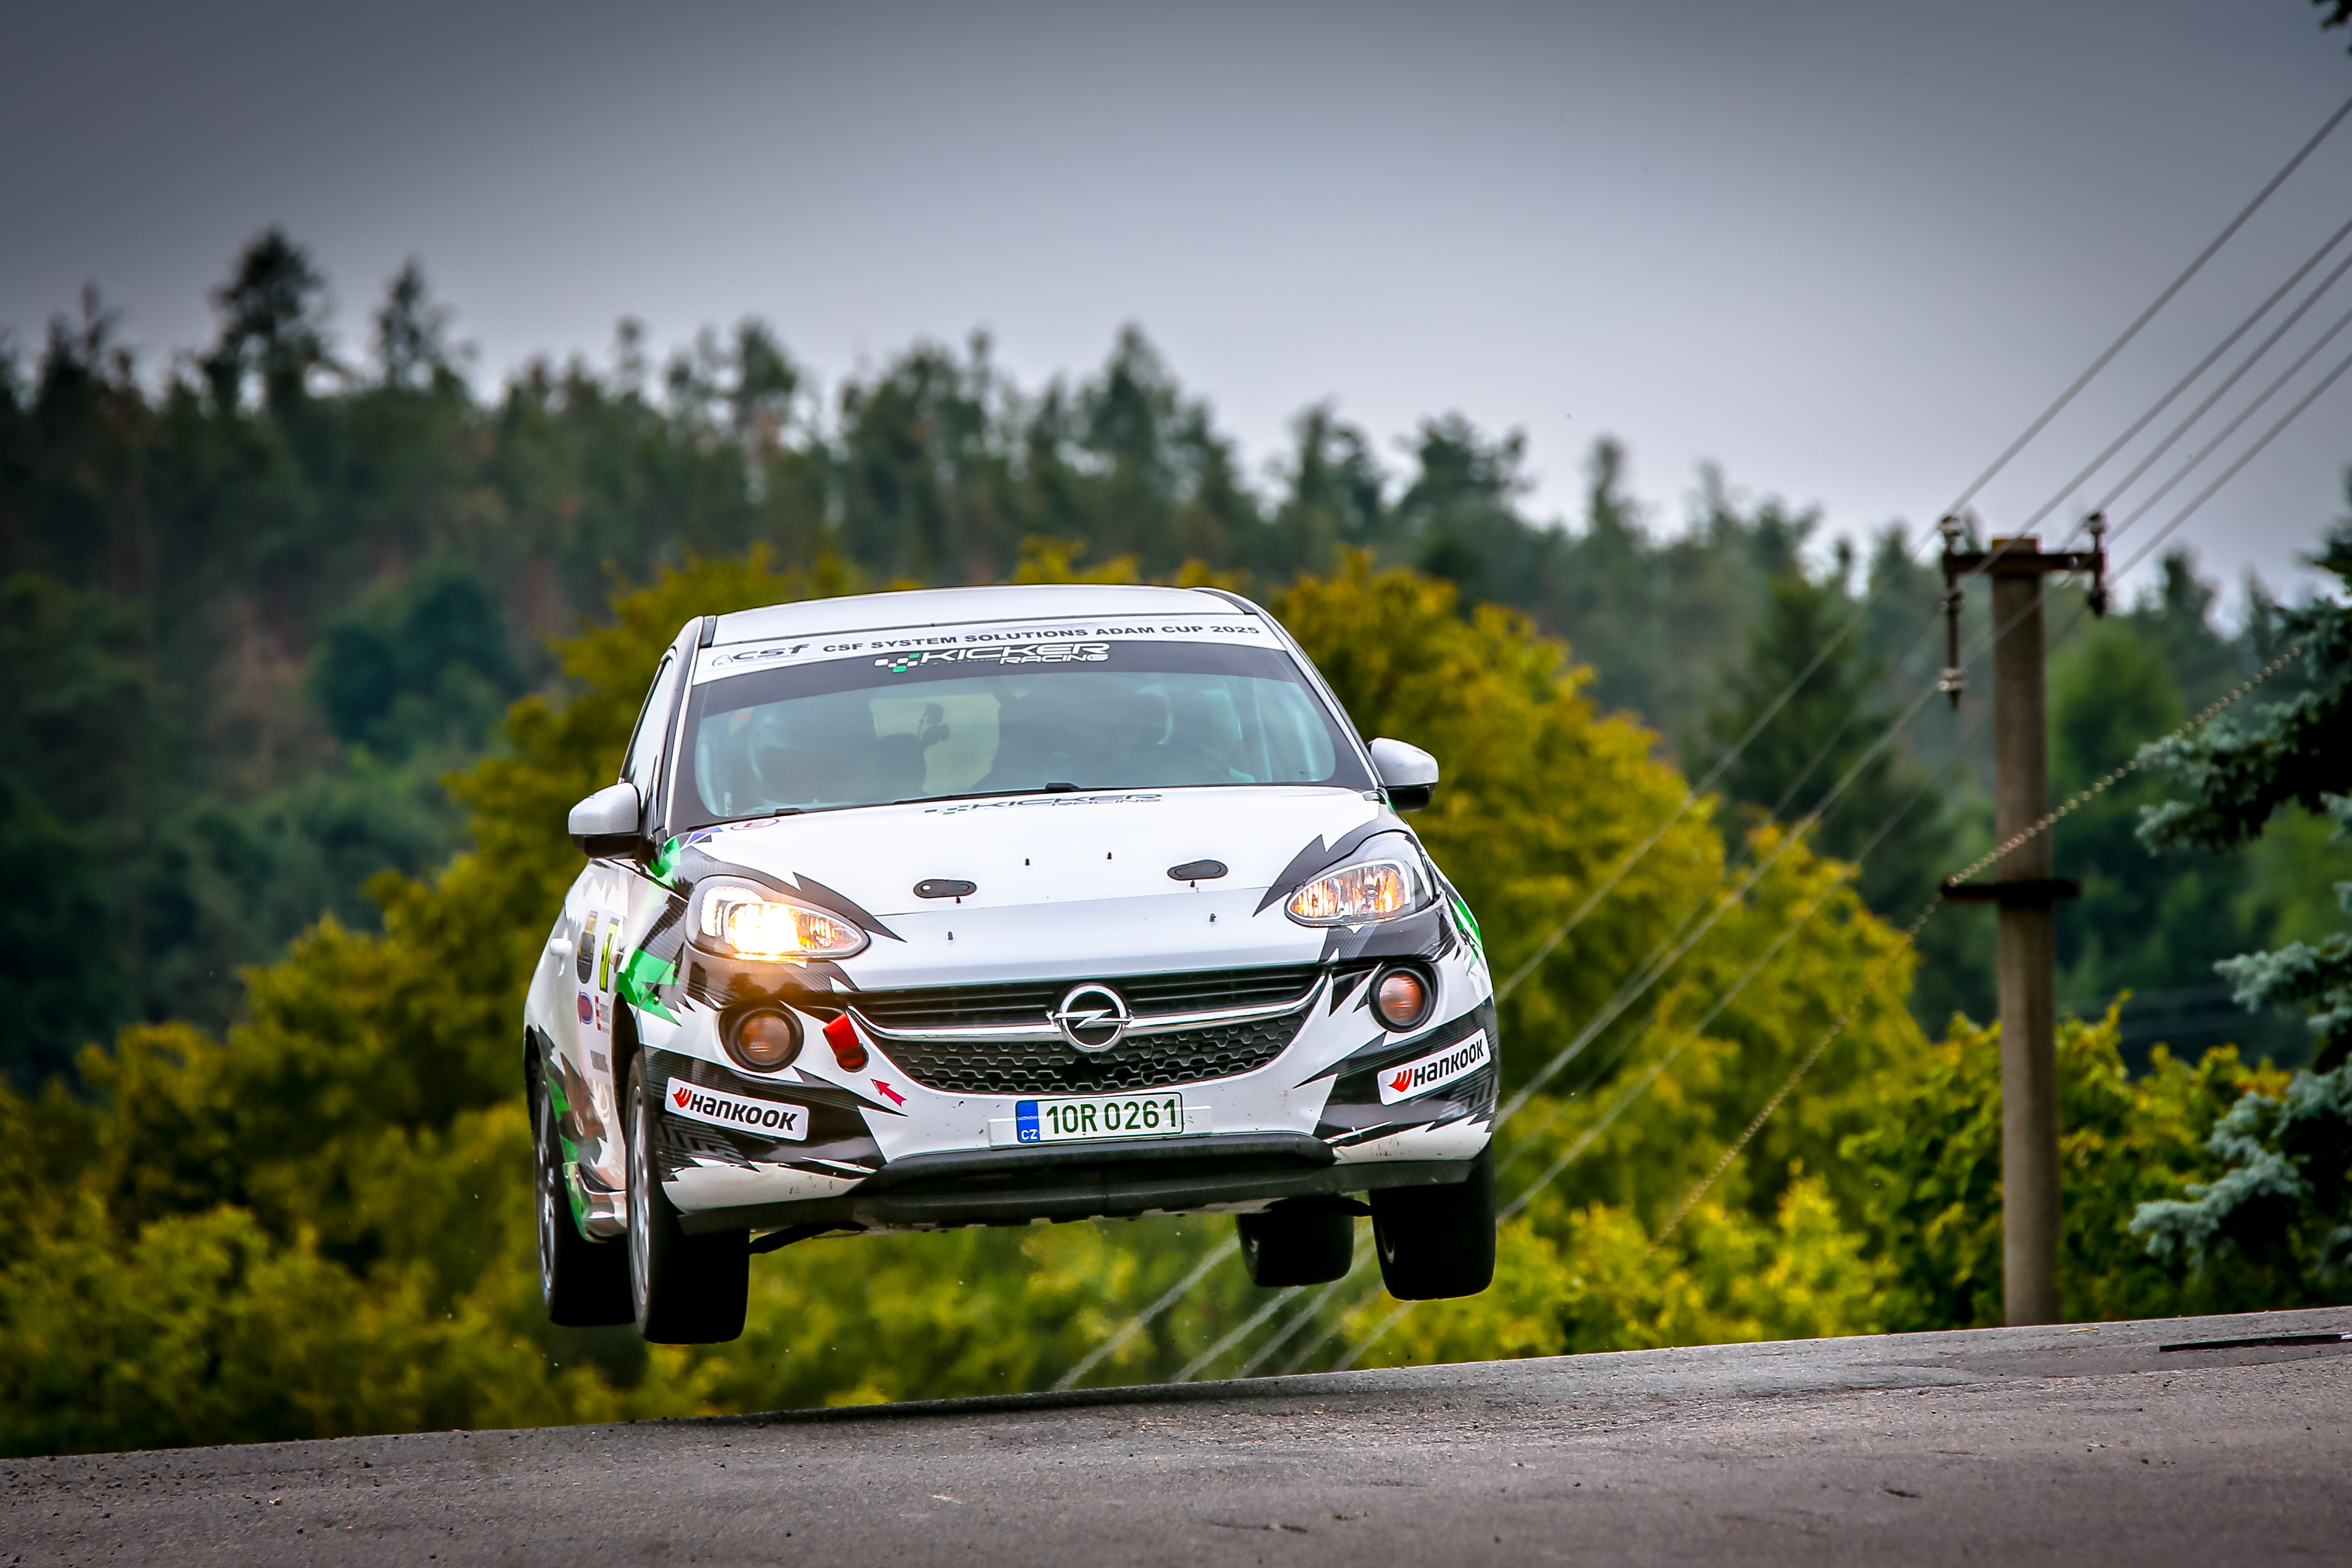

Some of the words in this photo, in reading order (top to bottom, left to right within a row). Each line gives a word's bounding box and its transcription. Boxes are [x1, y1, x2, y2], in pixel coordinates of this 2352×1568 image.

[823, 643, 863, 652] CSF
[869, 636, 957, 648] SYSTEM
[964, 629, 1088, 642] SOLUTIONS
[1096, 626, 1155, 635] ADAM
[1210, 625, 1260, 634] 2025
[920, 643, 1109, 663] KICKER
[999, 654, 1109, 664] RACING
[972, 794, 1162, 809] KICKER
[1046, 1104, 1098, 1135] 10R
[1104, 1098, 1175, 1131] 0261
[1021, 1129, 1038, 1140] CZ
